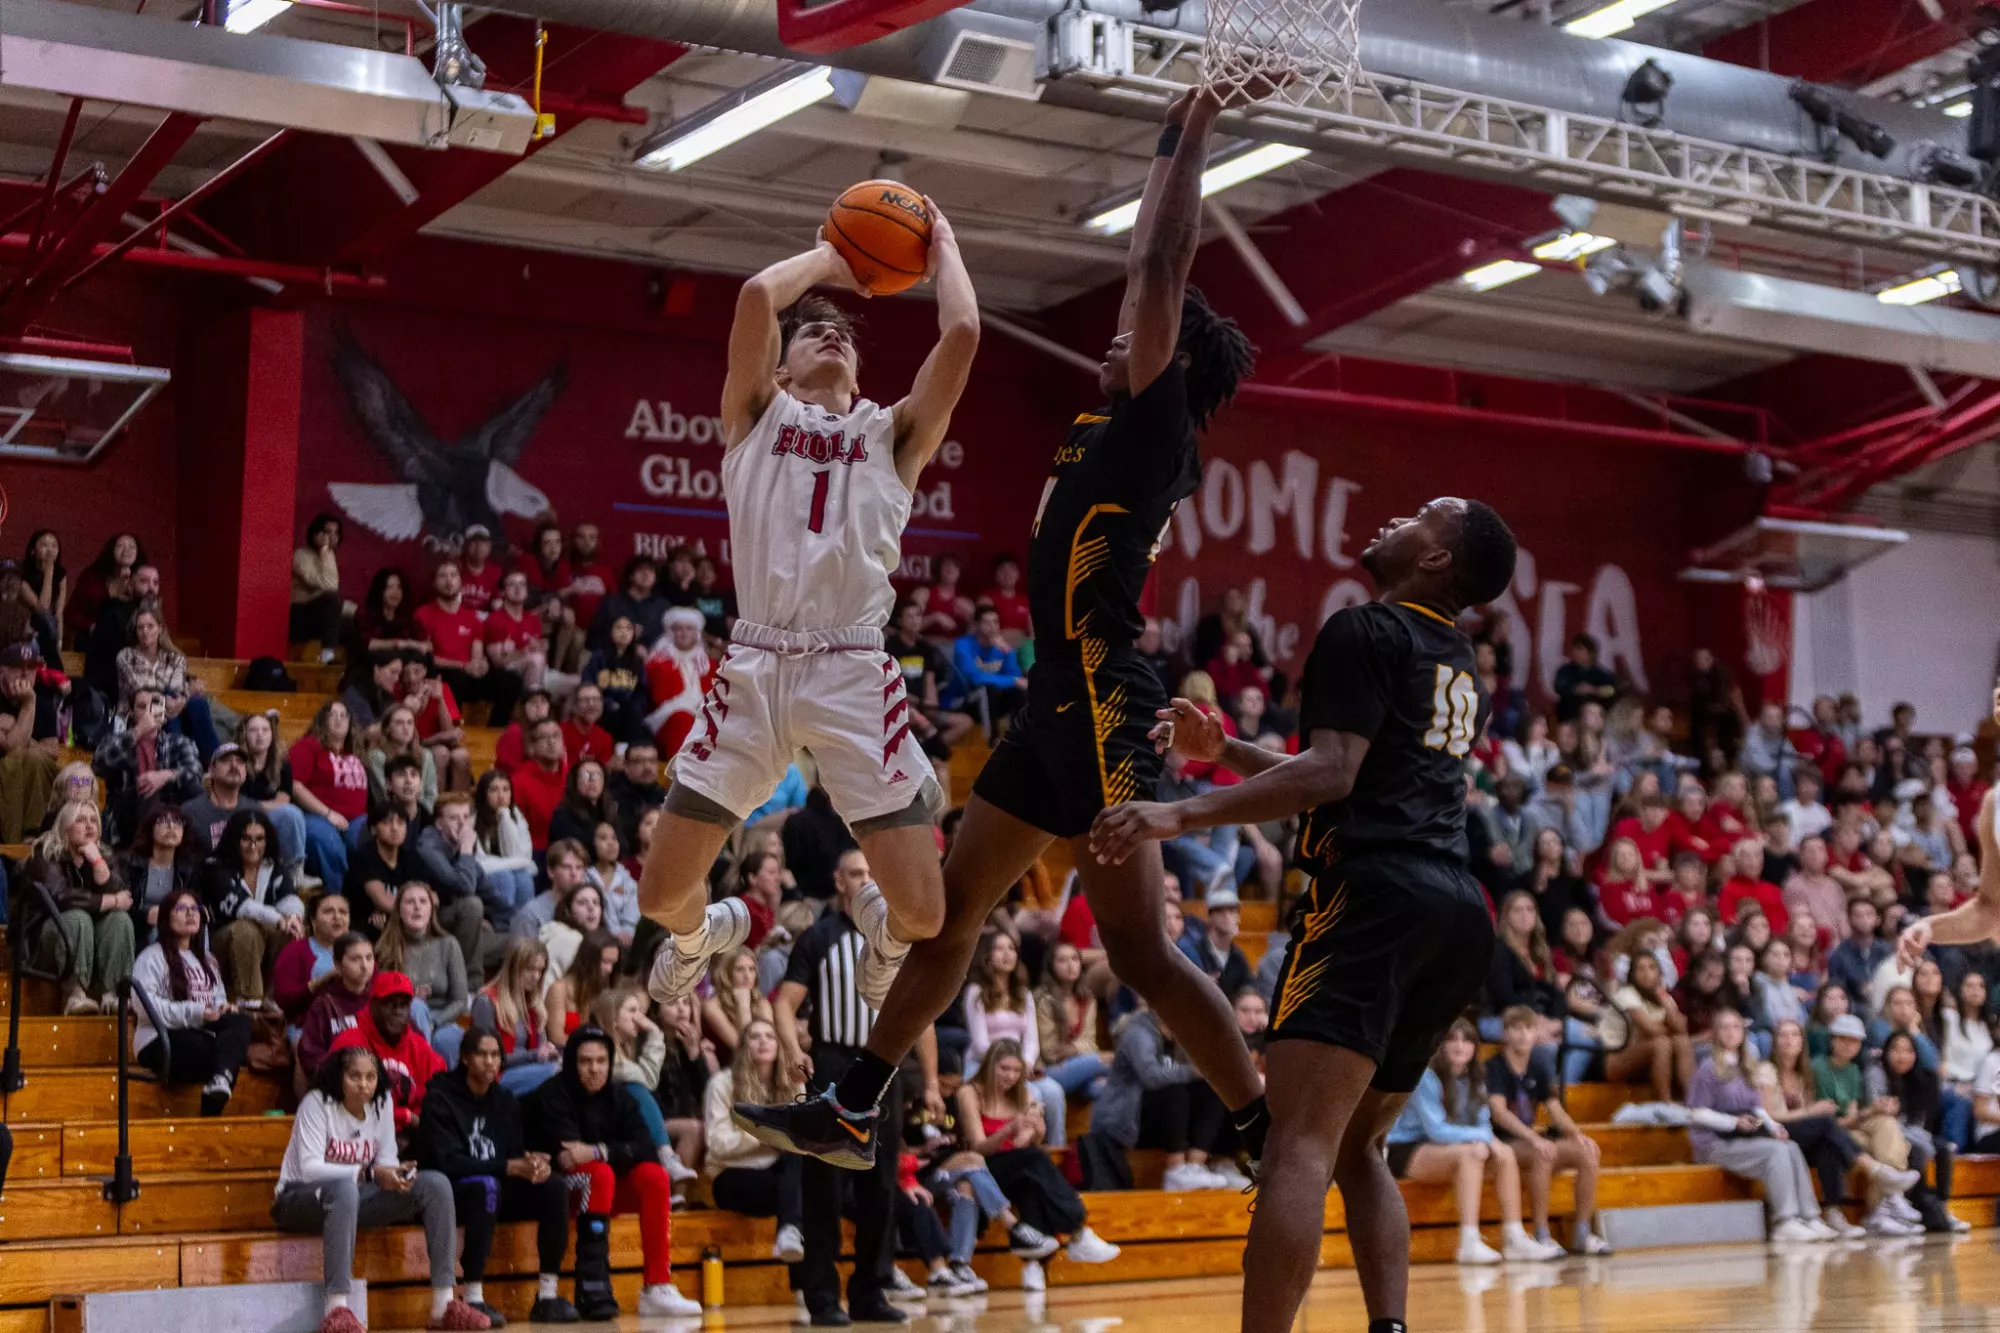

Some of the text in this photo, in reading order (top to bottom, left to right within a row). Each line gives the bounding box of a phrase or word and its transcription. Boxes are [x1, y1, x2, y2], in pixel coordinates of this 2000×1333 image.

[625, 399, 727, 446] Abov
[772, 423, 868, 465] BIOLA
[808, 469, 830, 534] 1
[1424, 663, 1479, 760] 10
